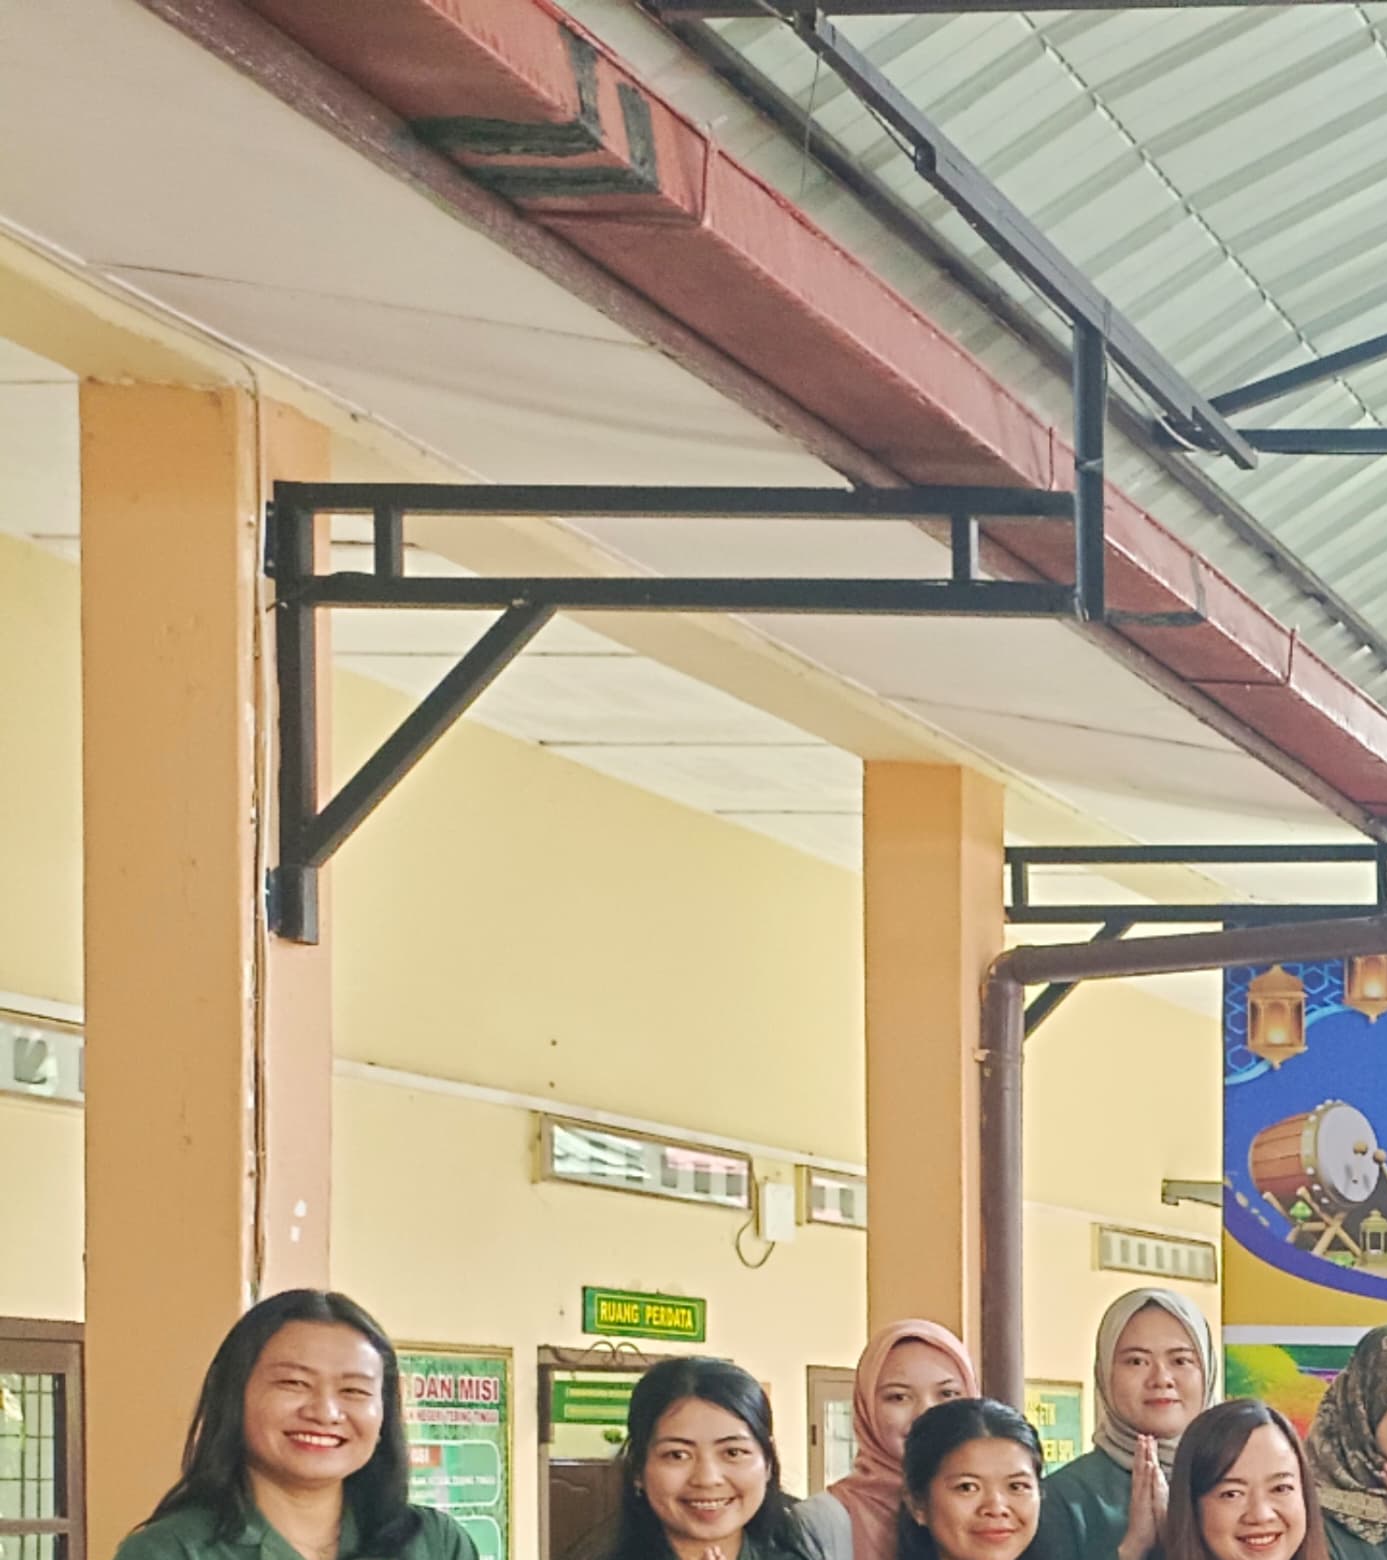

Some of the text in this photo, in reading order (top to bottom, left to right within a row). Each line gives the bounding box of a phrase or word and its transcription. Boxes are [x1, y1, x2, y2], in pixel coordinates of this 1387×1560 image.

[600, 1300, 693, 1329] RUANG PERDATA
[414, 1375, 499, 1402] DAN MISI
